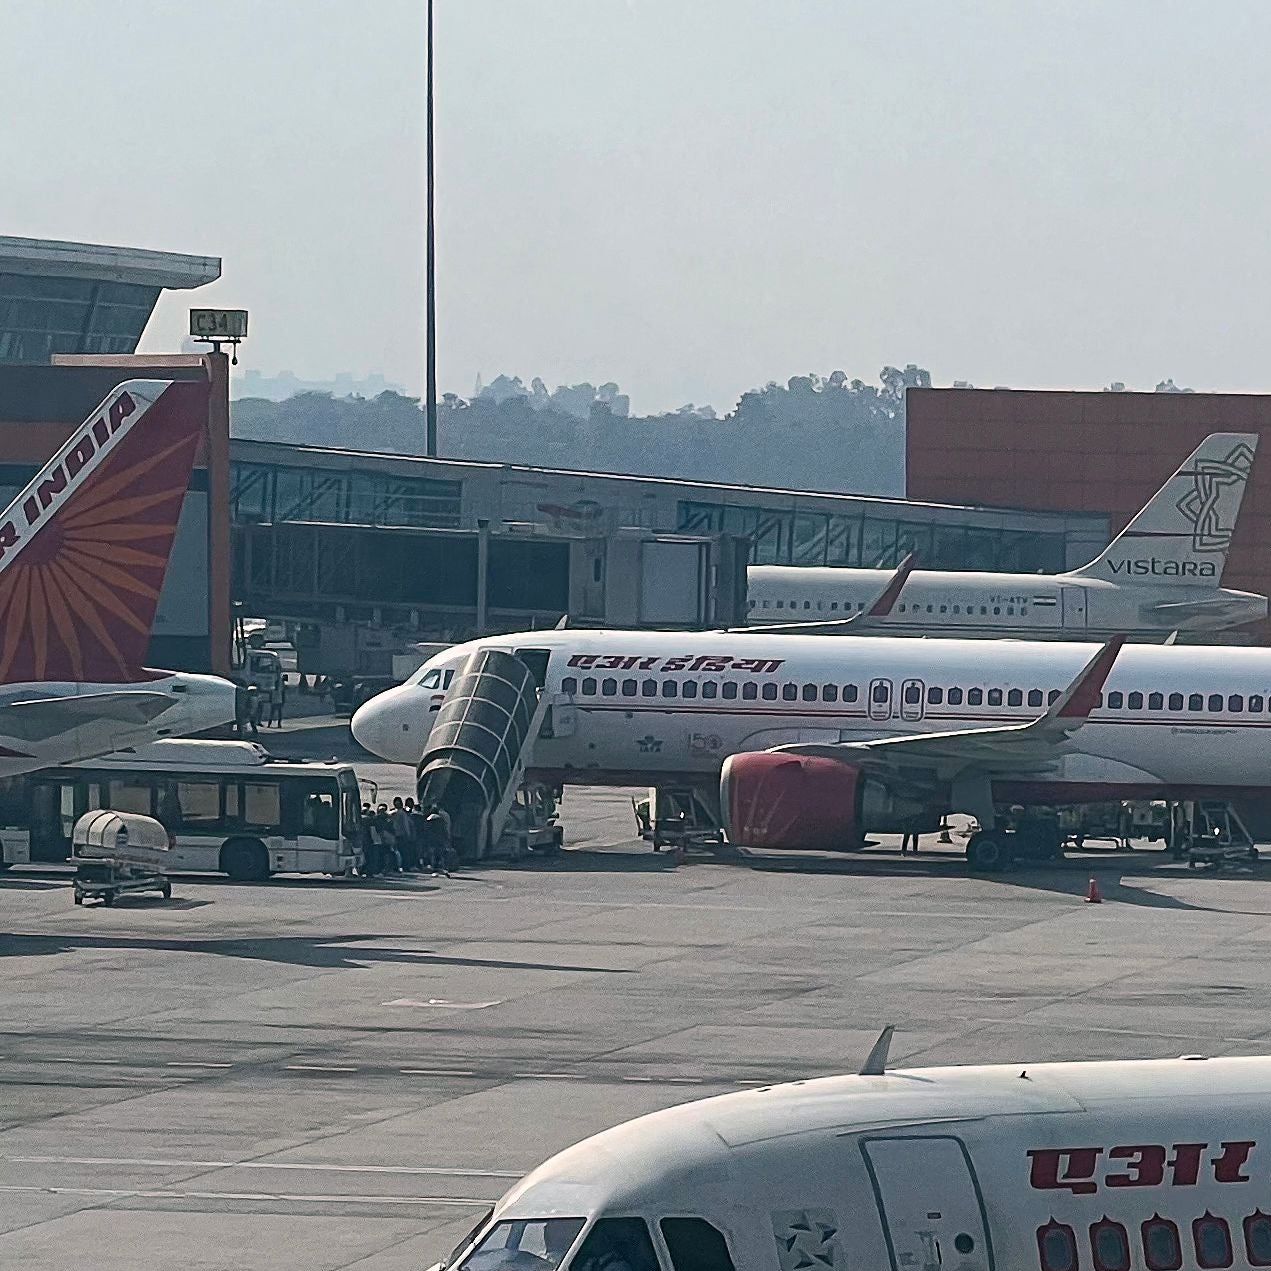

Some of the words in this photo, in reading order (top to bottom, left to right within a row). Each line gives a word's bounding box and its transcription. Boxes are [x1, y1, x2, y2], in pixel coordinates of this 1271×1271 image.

[23, 391, 137, 526] INDIA
[567, 653, 663, 671] एअर
[660, 654, 786, 673] इंडिया
[1026, 1140, 1257, 1196] एअर
